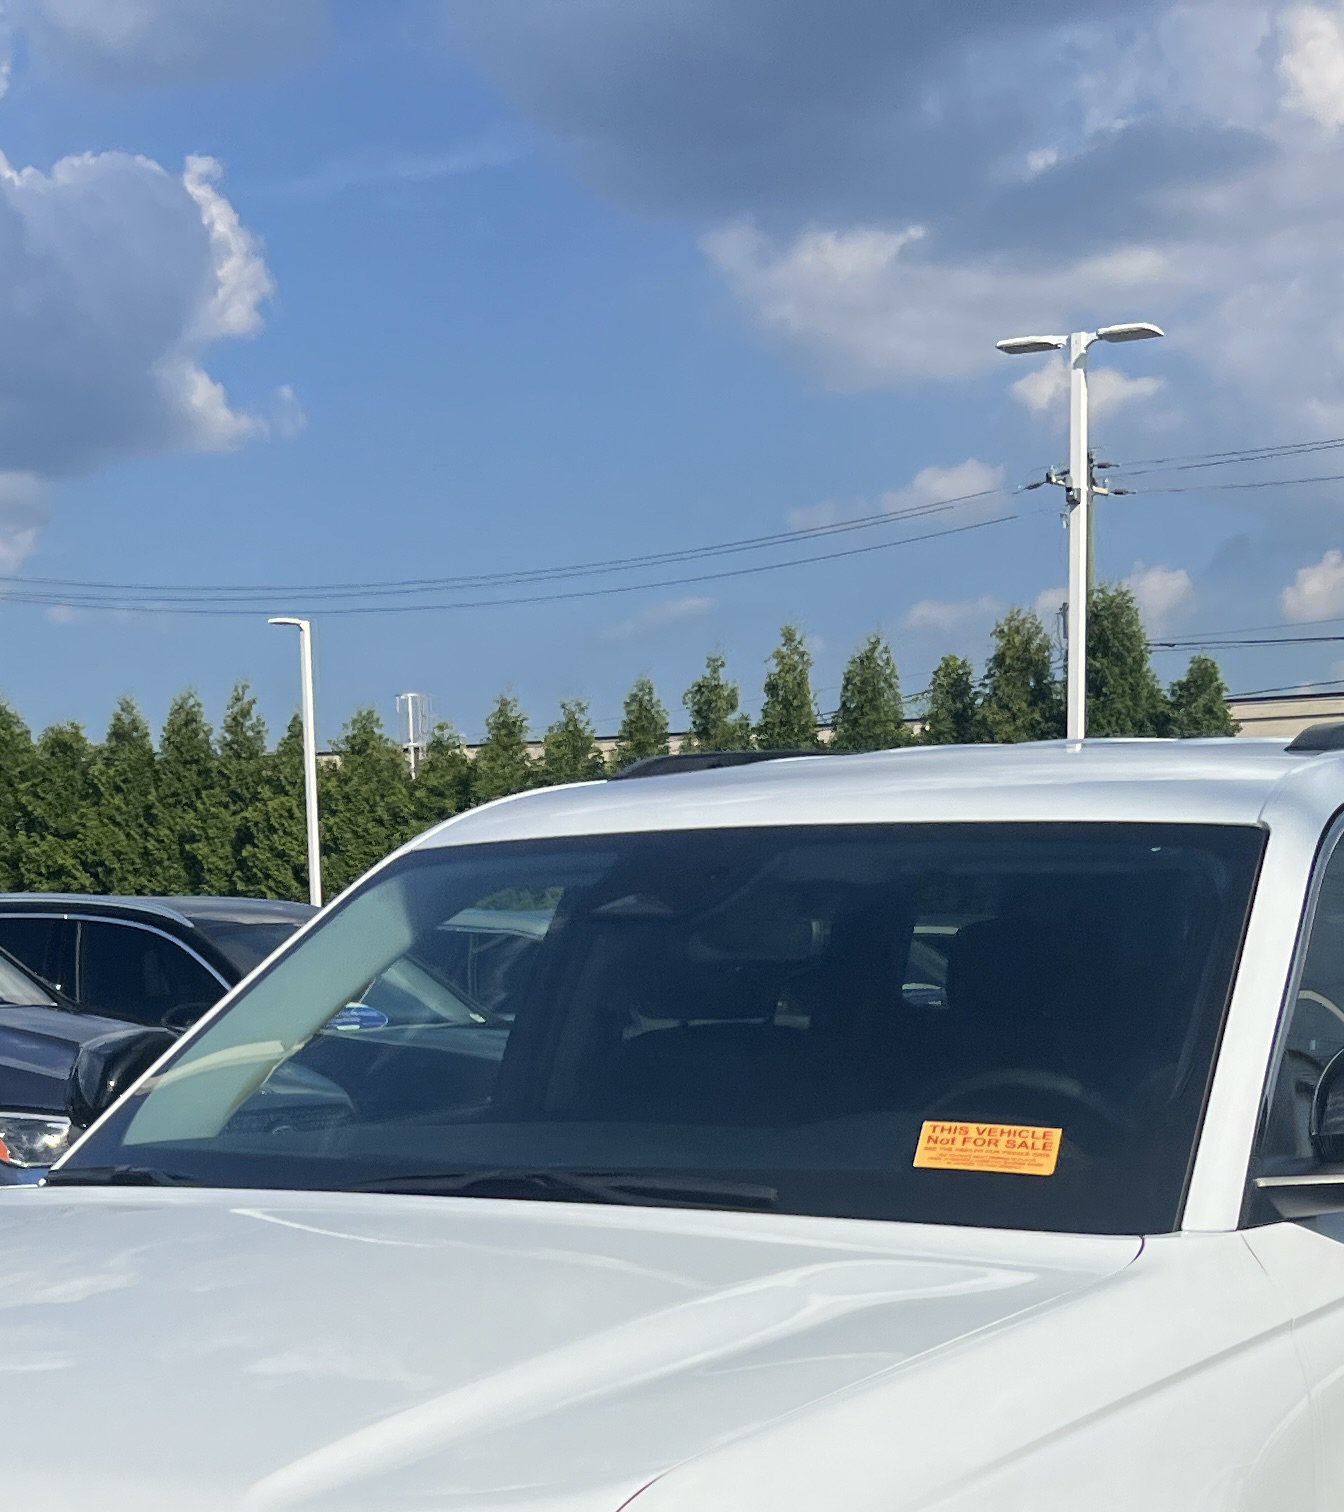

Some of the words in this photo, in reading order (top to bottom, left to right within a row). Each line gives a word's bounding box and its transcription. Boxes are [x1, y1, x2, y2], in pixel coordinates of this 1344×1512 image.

[929, 1124, 970, 1137] THIS
[975, 1126, 1054, 1141] VEHICLE
[927, 1135, 957, 1146] Not
[962, 1137, 999, 1149] FOR
[1005, 1139, 1053, 1152] SALE
